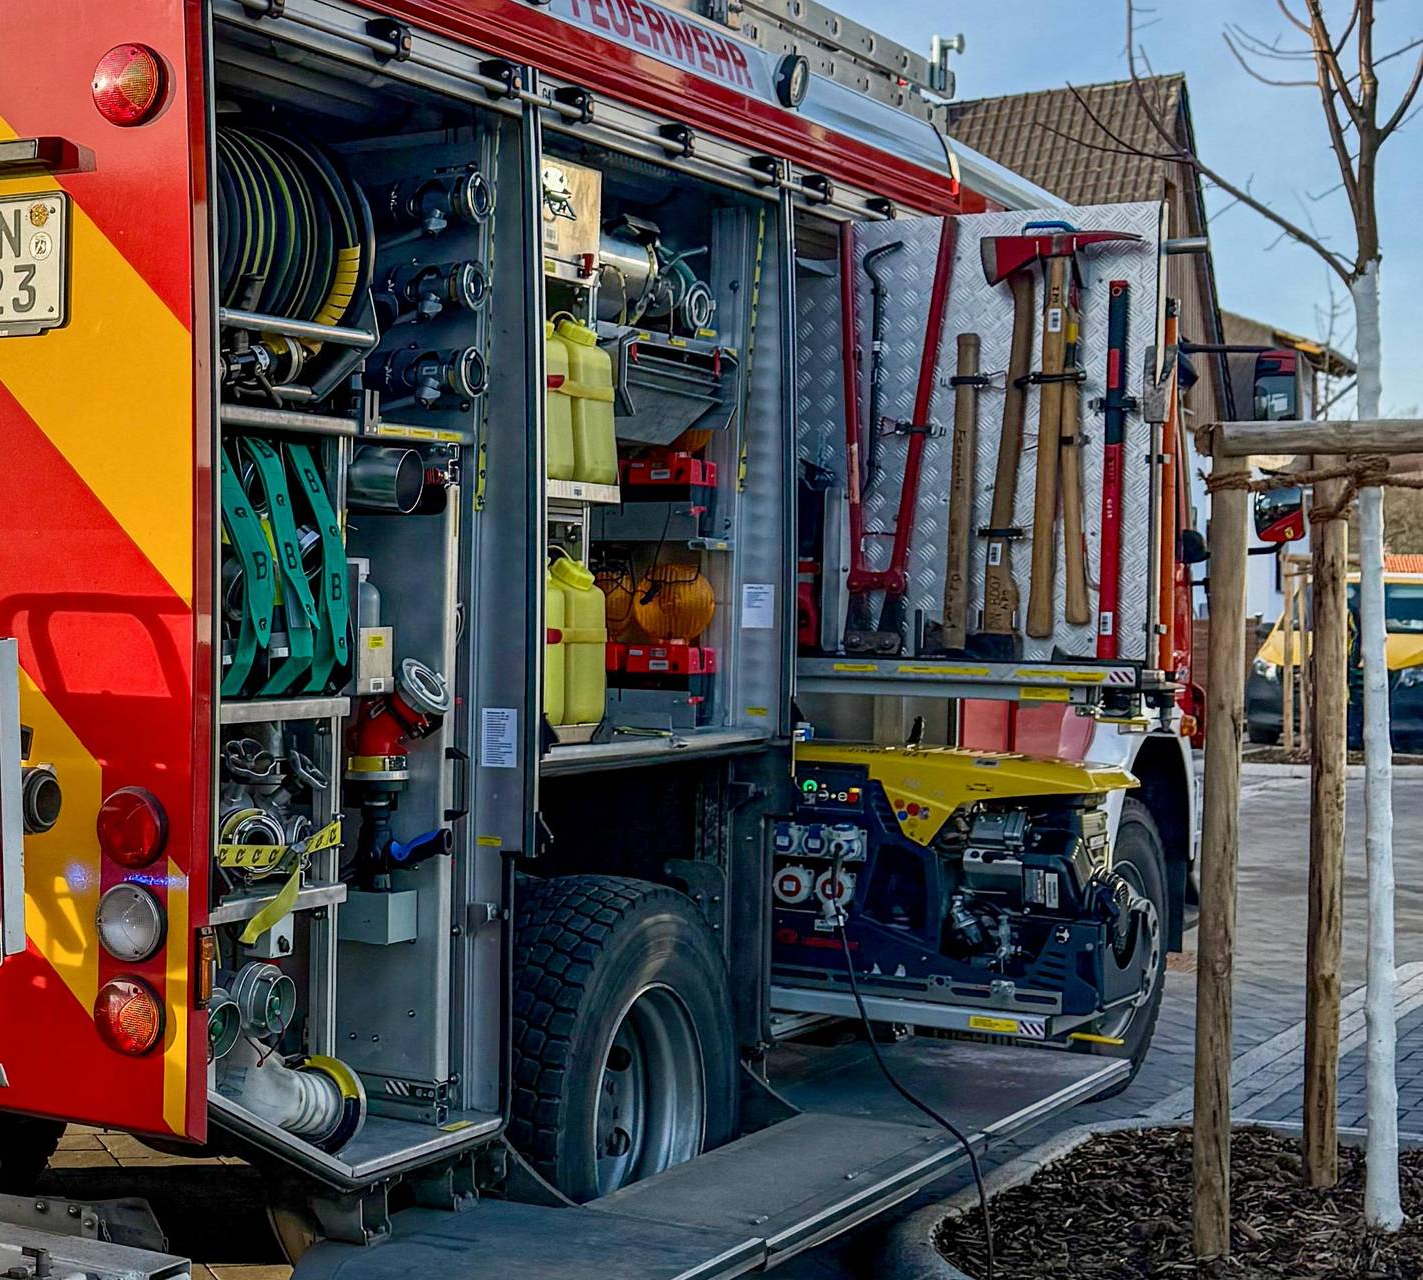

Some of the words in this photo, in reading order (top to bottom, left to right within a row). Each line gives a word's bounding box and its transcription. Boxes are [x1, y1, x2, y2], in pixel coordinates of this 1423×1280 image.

[252, 551, 267, 580] B
[284, 542, 297, 569] B
[332, 573, 342, 601] B
